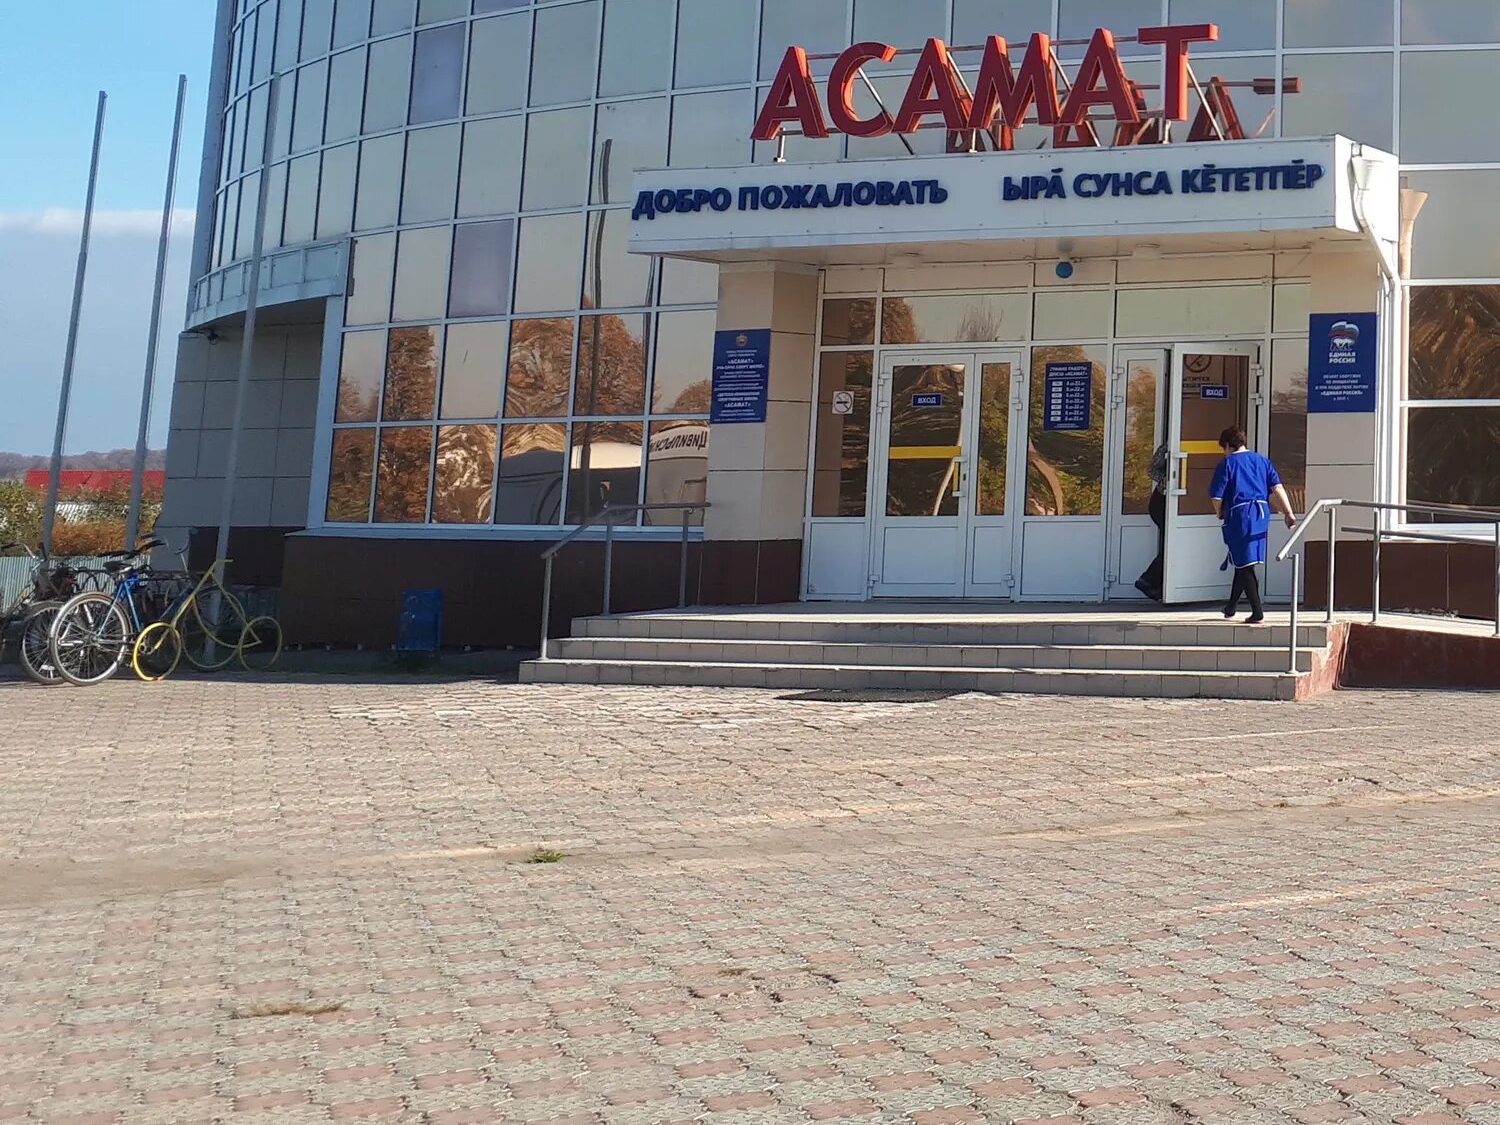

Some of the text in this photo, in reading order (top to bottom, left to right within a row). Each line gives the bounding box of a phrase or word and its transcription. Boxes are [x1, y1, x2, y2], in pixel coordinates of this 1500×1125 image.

[750, 22, 1219, 142] АСАМАТ
[1072, 170, 1173, 198] СУНСА
[631, 179, 949, 221] ДОБРО ПОЖАЛОВАТЬ
[917, 396, 937, 404] ВХОД
[1205, 388, 1224, 397] ВХОД
